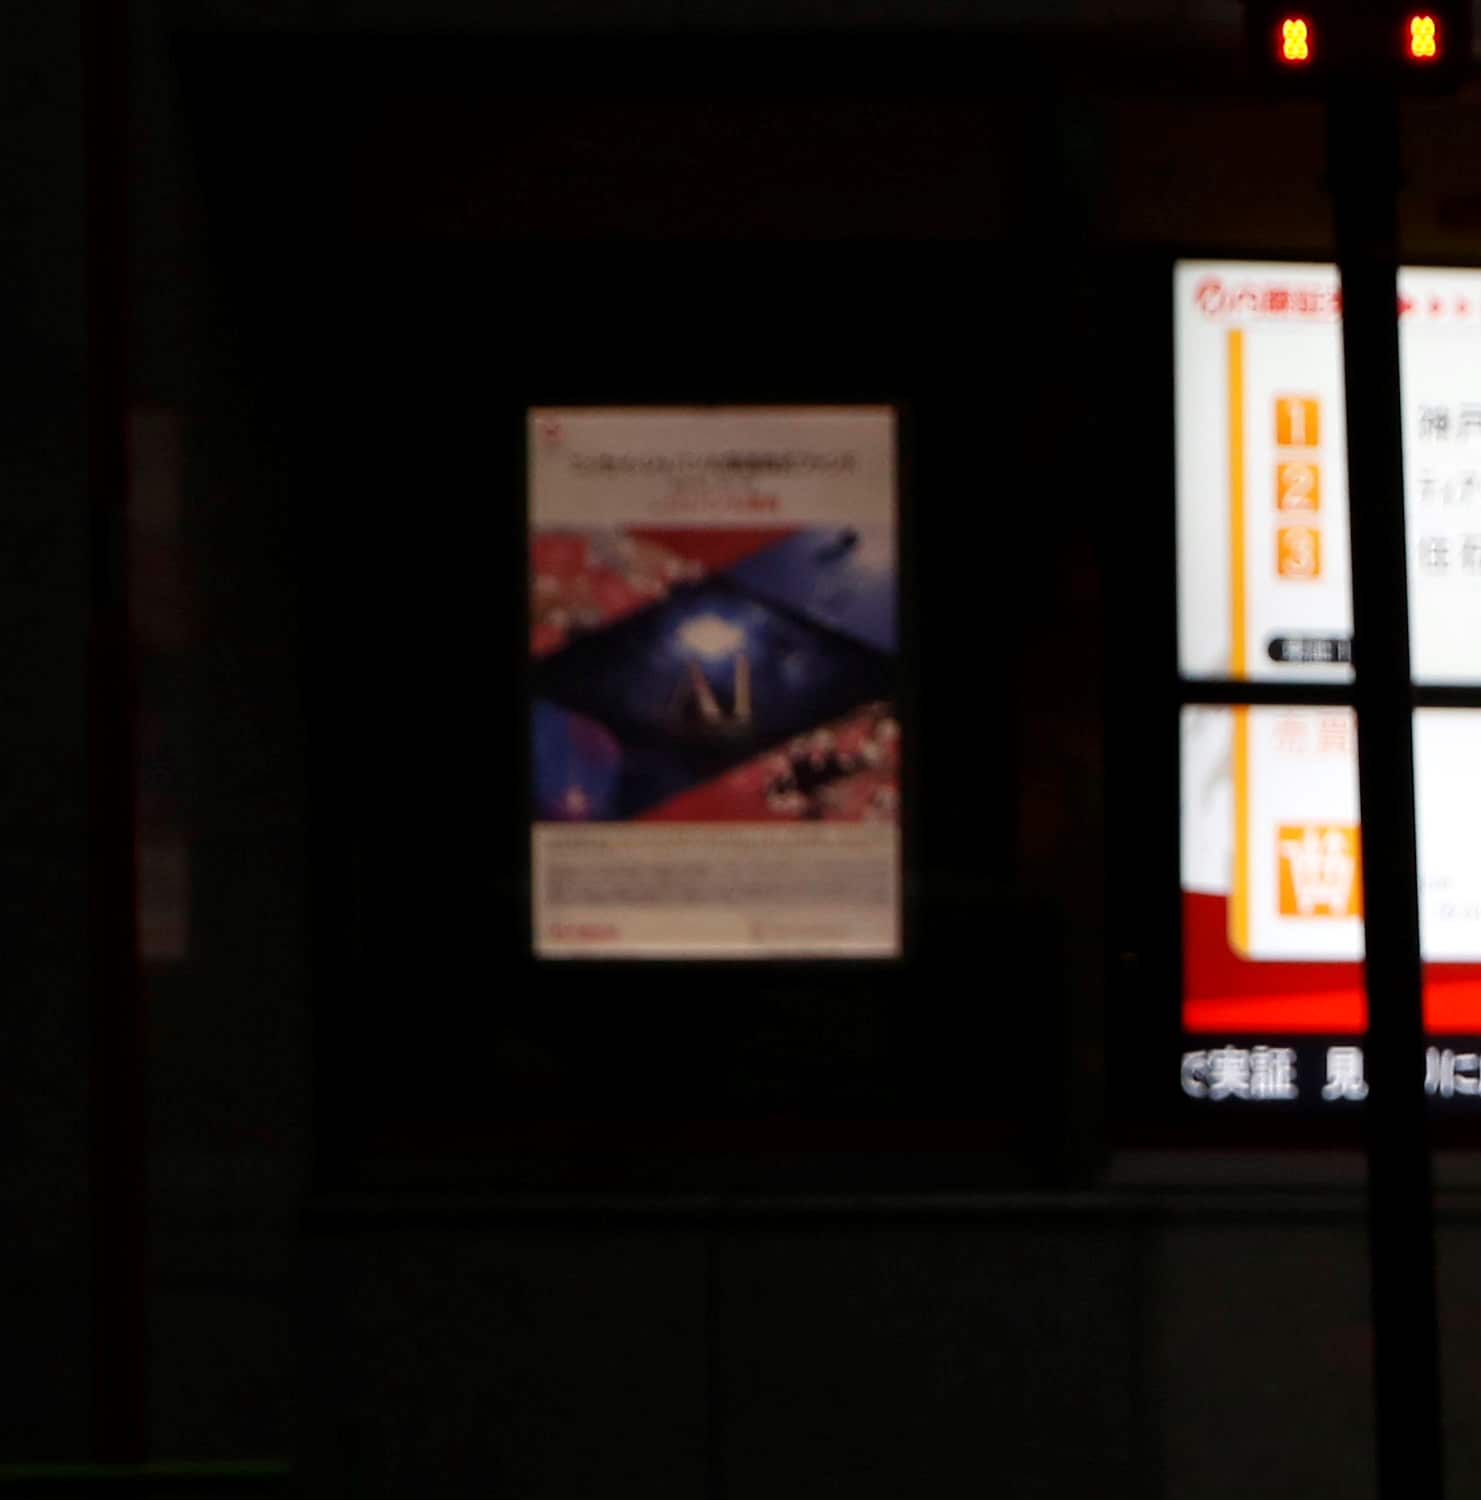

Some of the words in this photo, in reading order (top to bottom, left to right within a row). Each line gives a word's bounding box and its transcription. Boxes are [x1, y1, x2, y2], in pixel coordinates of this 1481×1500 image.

[1283, 402, 1307, 443] 1
[1278, 466, 1316, 508] 2
[1280, 530, 1316, 575] 3
